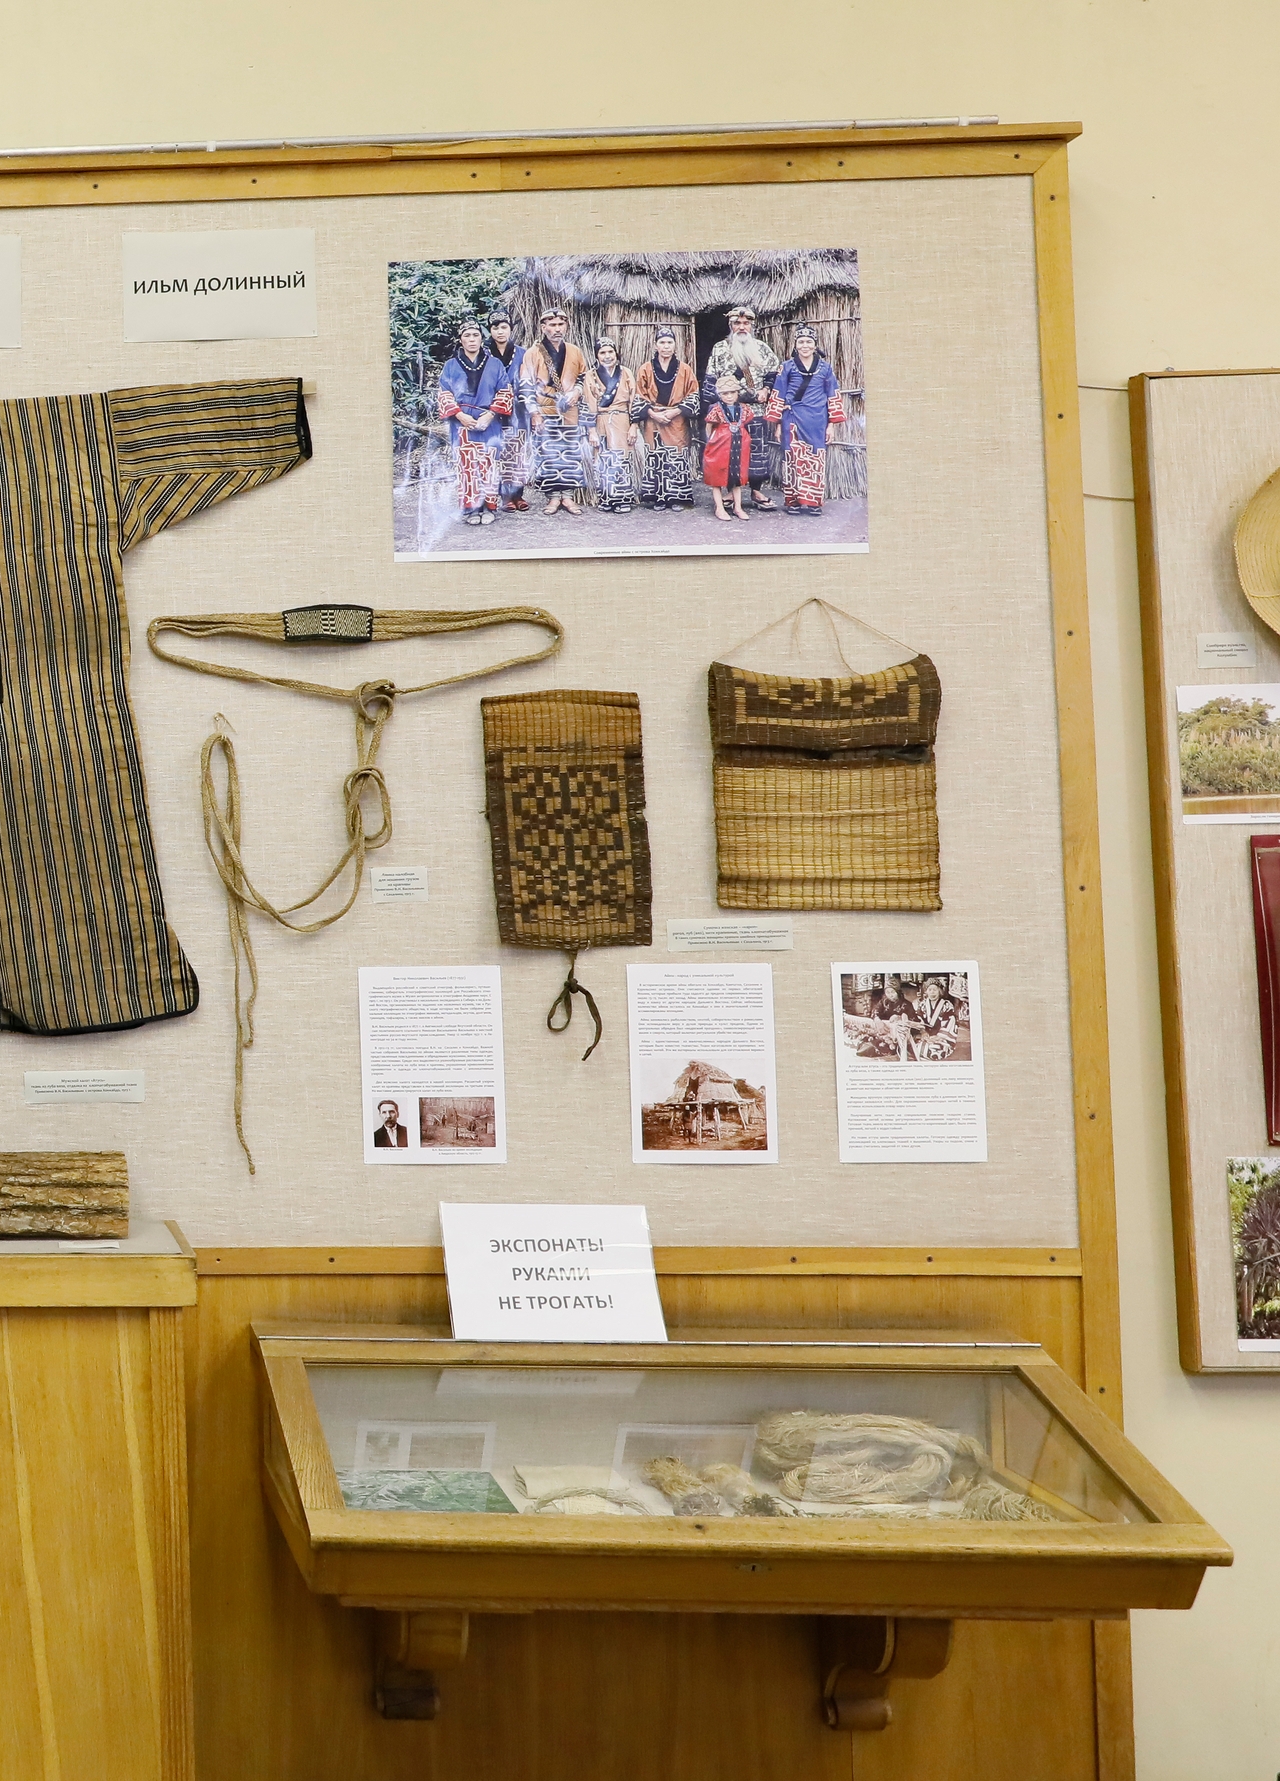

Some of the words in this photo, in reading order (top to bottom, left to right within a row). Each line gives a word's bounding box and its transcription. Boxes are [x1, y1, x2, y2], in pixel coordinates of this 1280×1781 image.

[133, 278, 189, 294] ИЛЬМ
[193, 270, 306, 296] ДОЛИННЫЙ
[489, 1238, 604, 1253] ЭКСПОНАТЫ
[512, 1267, 591, 1282] РУКАМИ
[499, 1296, 521, 1310] НЕ
[526, 1294, 614, 1310] ТРОГАТЬ!
